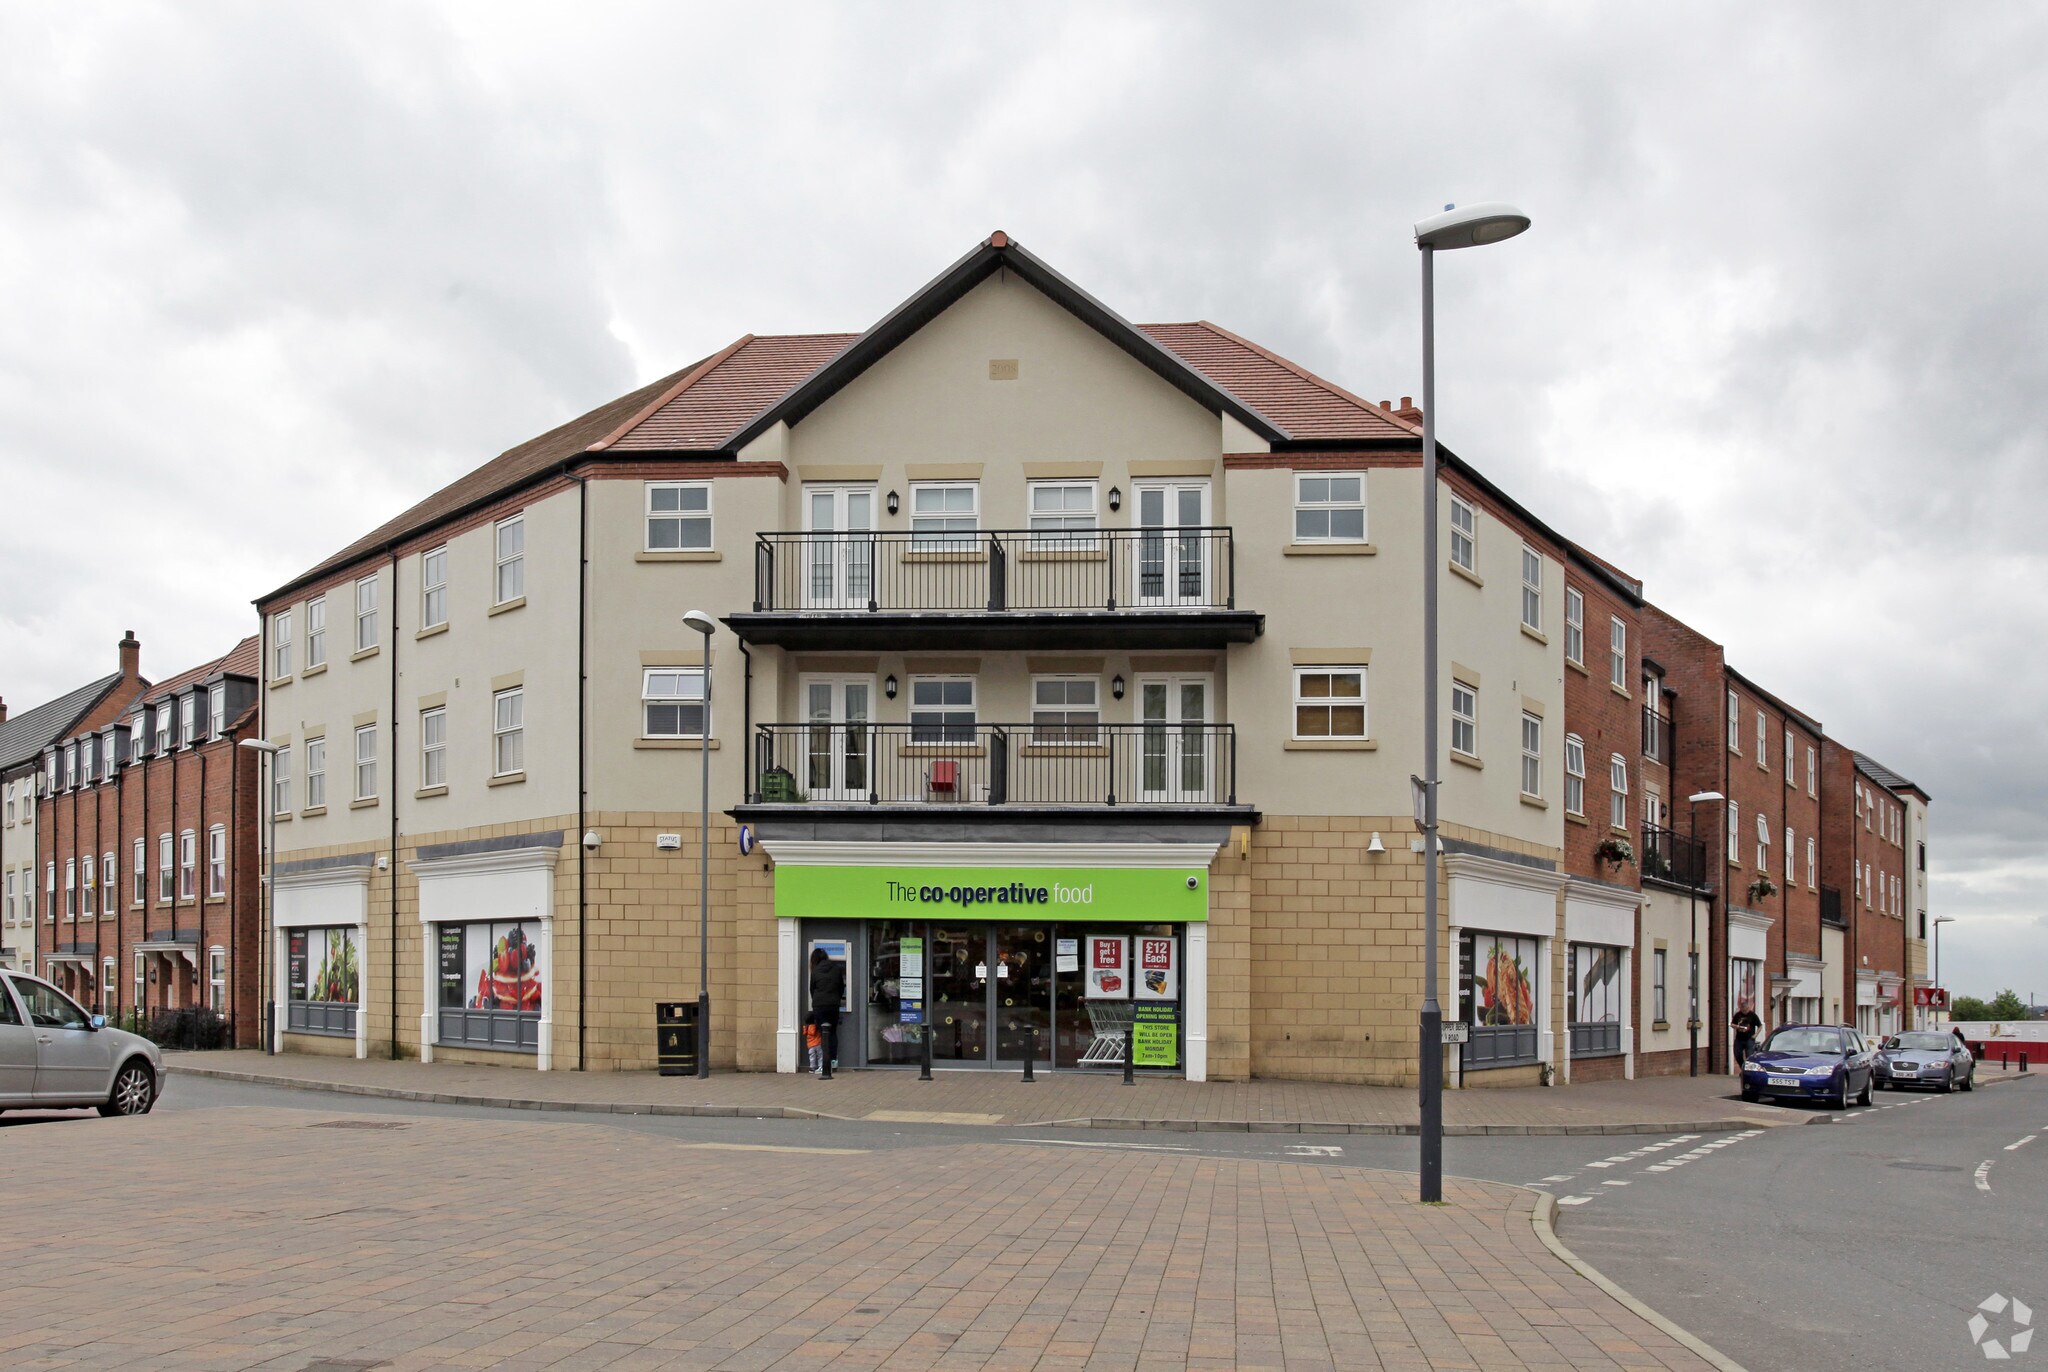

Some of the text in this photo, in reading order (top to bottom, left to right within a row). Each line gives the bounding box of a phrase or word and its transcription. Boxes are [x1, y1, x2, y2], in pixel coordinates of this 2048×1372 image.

[886, 882, 1093, 907] The co-operative food
[1100, 941, 1110, 949] Buy
[1146, 942, 1167, 954] £12
[1100, 948, 1110, 957] get
[1100, 955, 1115, 964] free
[1146, 953, 1167, 963] Each
[1442, 1023, 1468, 1031] OPPER BEECH
